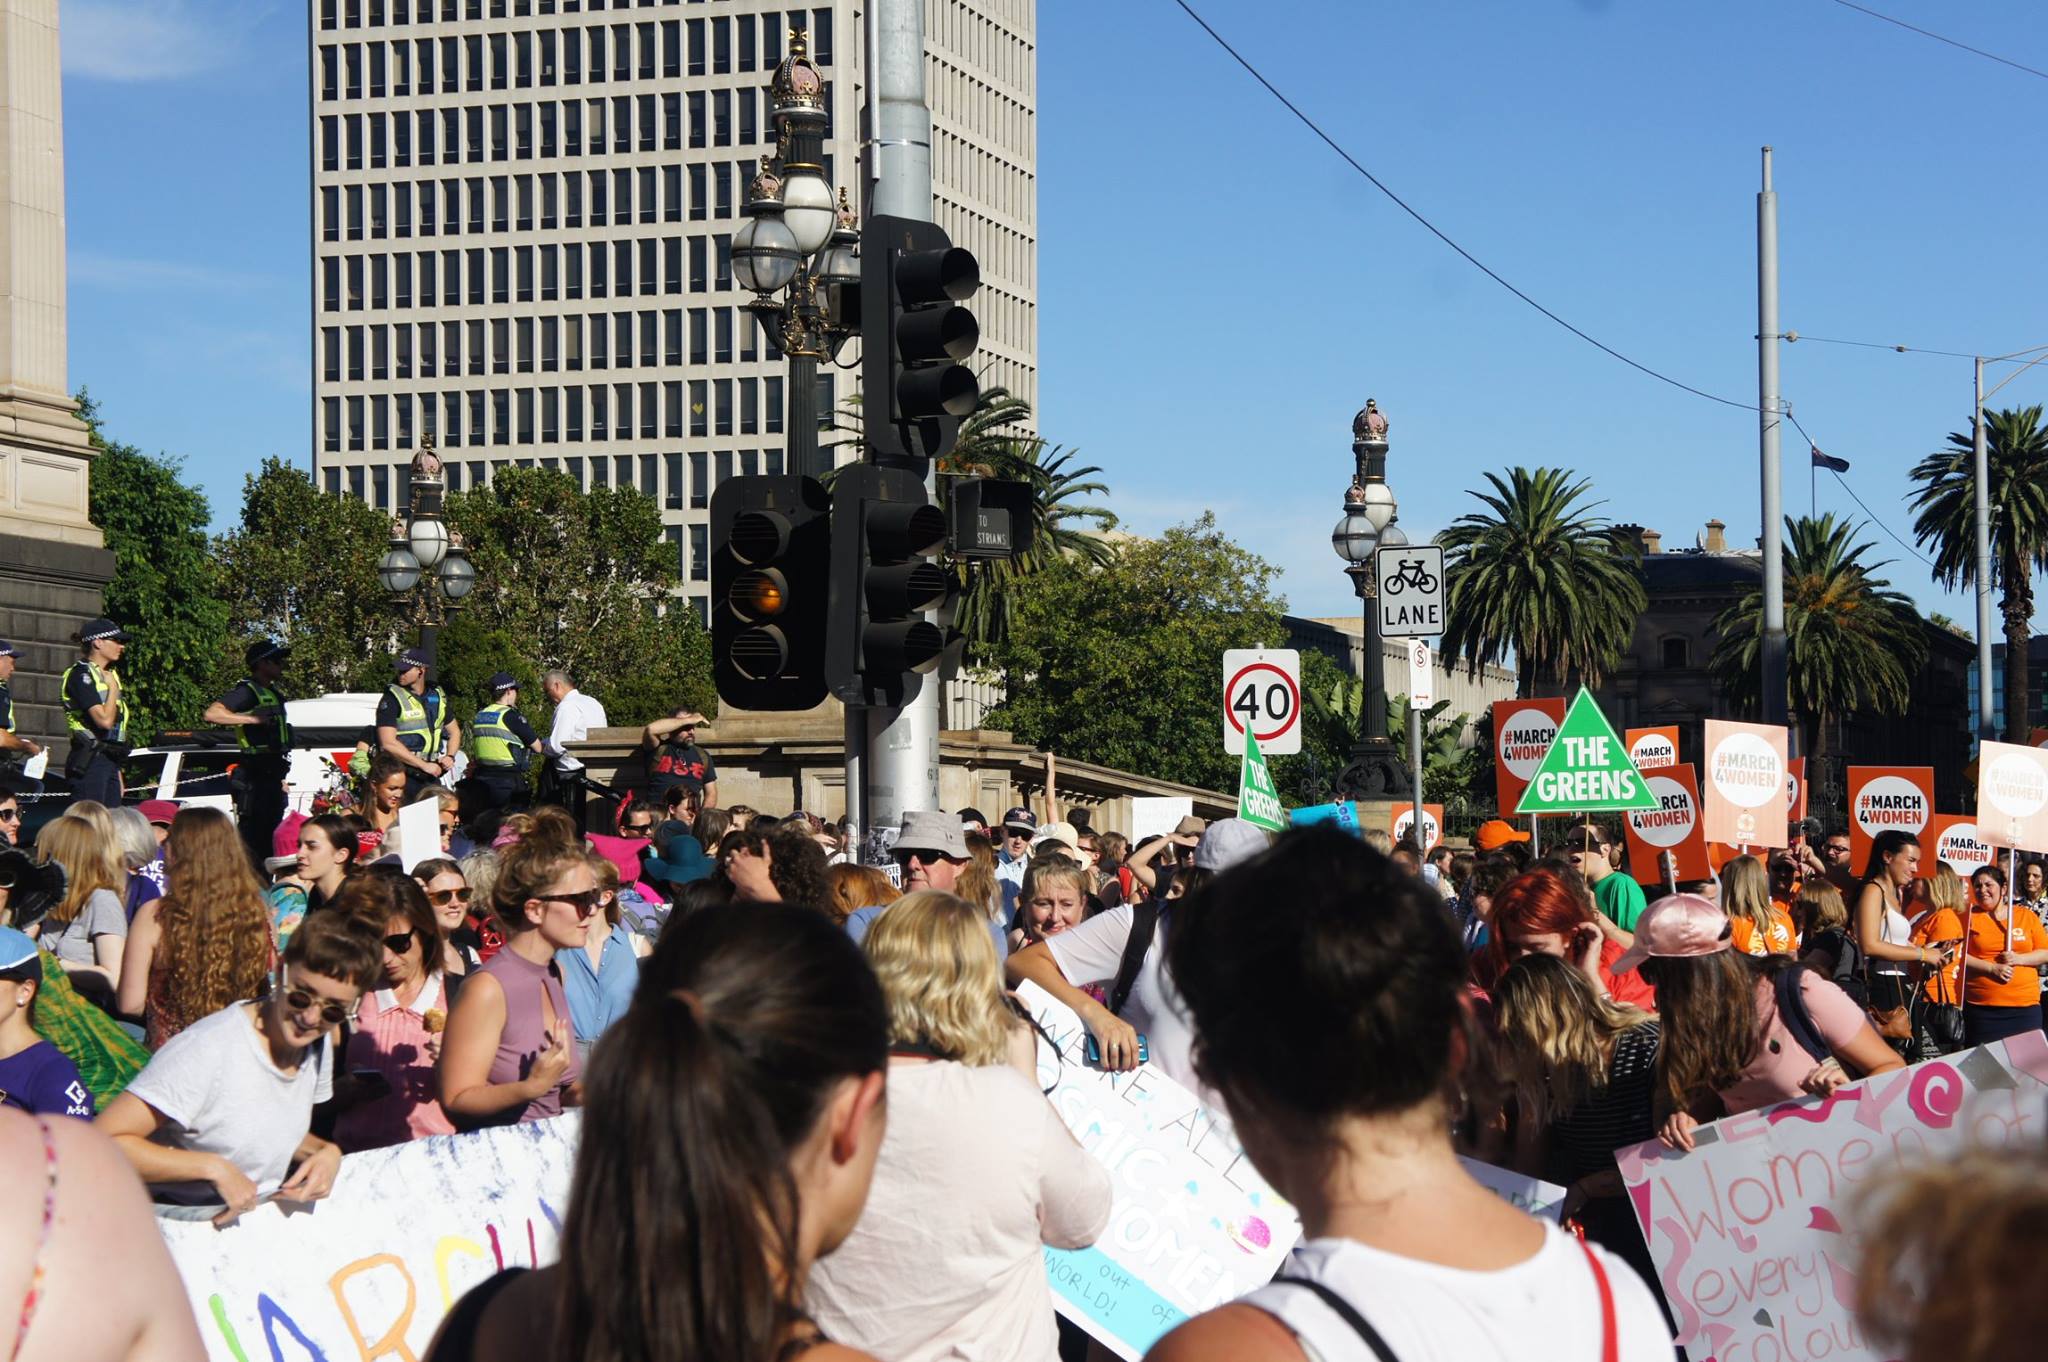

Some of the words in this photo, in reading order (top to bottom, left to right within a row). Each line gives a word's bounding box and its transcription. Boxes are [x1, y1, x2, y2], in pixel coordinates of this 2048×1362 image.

[978, 515, 988, 527] TO
[1385, 605, 1439, 625] LANE
[1233, 683, 1290, 720] 40
[1504, 728, 1556, 745] #MARCH
[1504, 745, 1548, 761] 4WOME
[1562, 736, 1610, 767] THE
[1634, 746, 1672, 757] #MARCH
[1717, 752, 1776, 771] #MARCH
[1248, 758, 1270, 792] THE
[1715, 768, 1776, 788] 4WOMEN
[1536, 769, 1636, 802] GREENS
[1244, 786, 1284, 827] GREENS
[1860, 795, 1921, 809] #MARCH
[1633, 809, 1691, 829] 4WOMEN
[1859, 810, 1922, 825] 4WOMEN
[1942, 836, 1988, 850] #MARCH
[1940, 848, 1988, 862] 4WOMEN
[1160, 1108, 1244, 1193] ALL
[1660, 1127, 1930, 1243] Women
[1043, 1250, 1118, 1318] WORLD!
[1691, 1249, 1825, 1316] every
[1099, 1263, 1132, 1290] out
[1151, 1303, 1178, 1325] of
